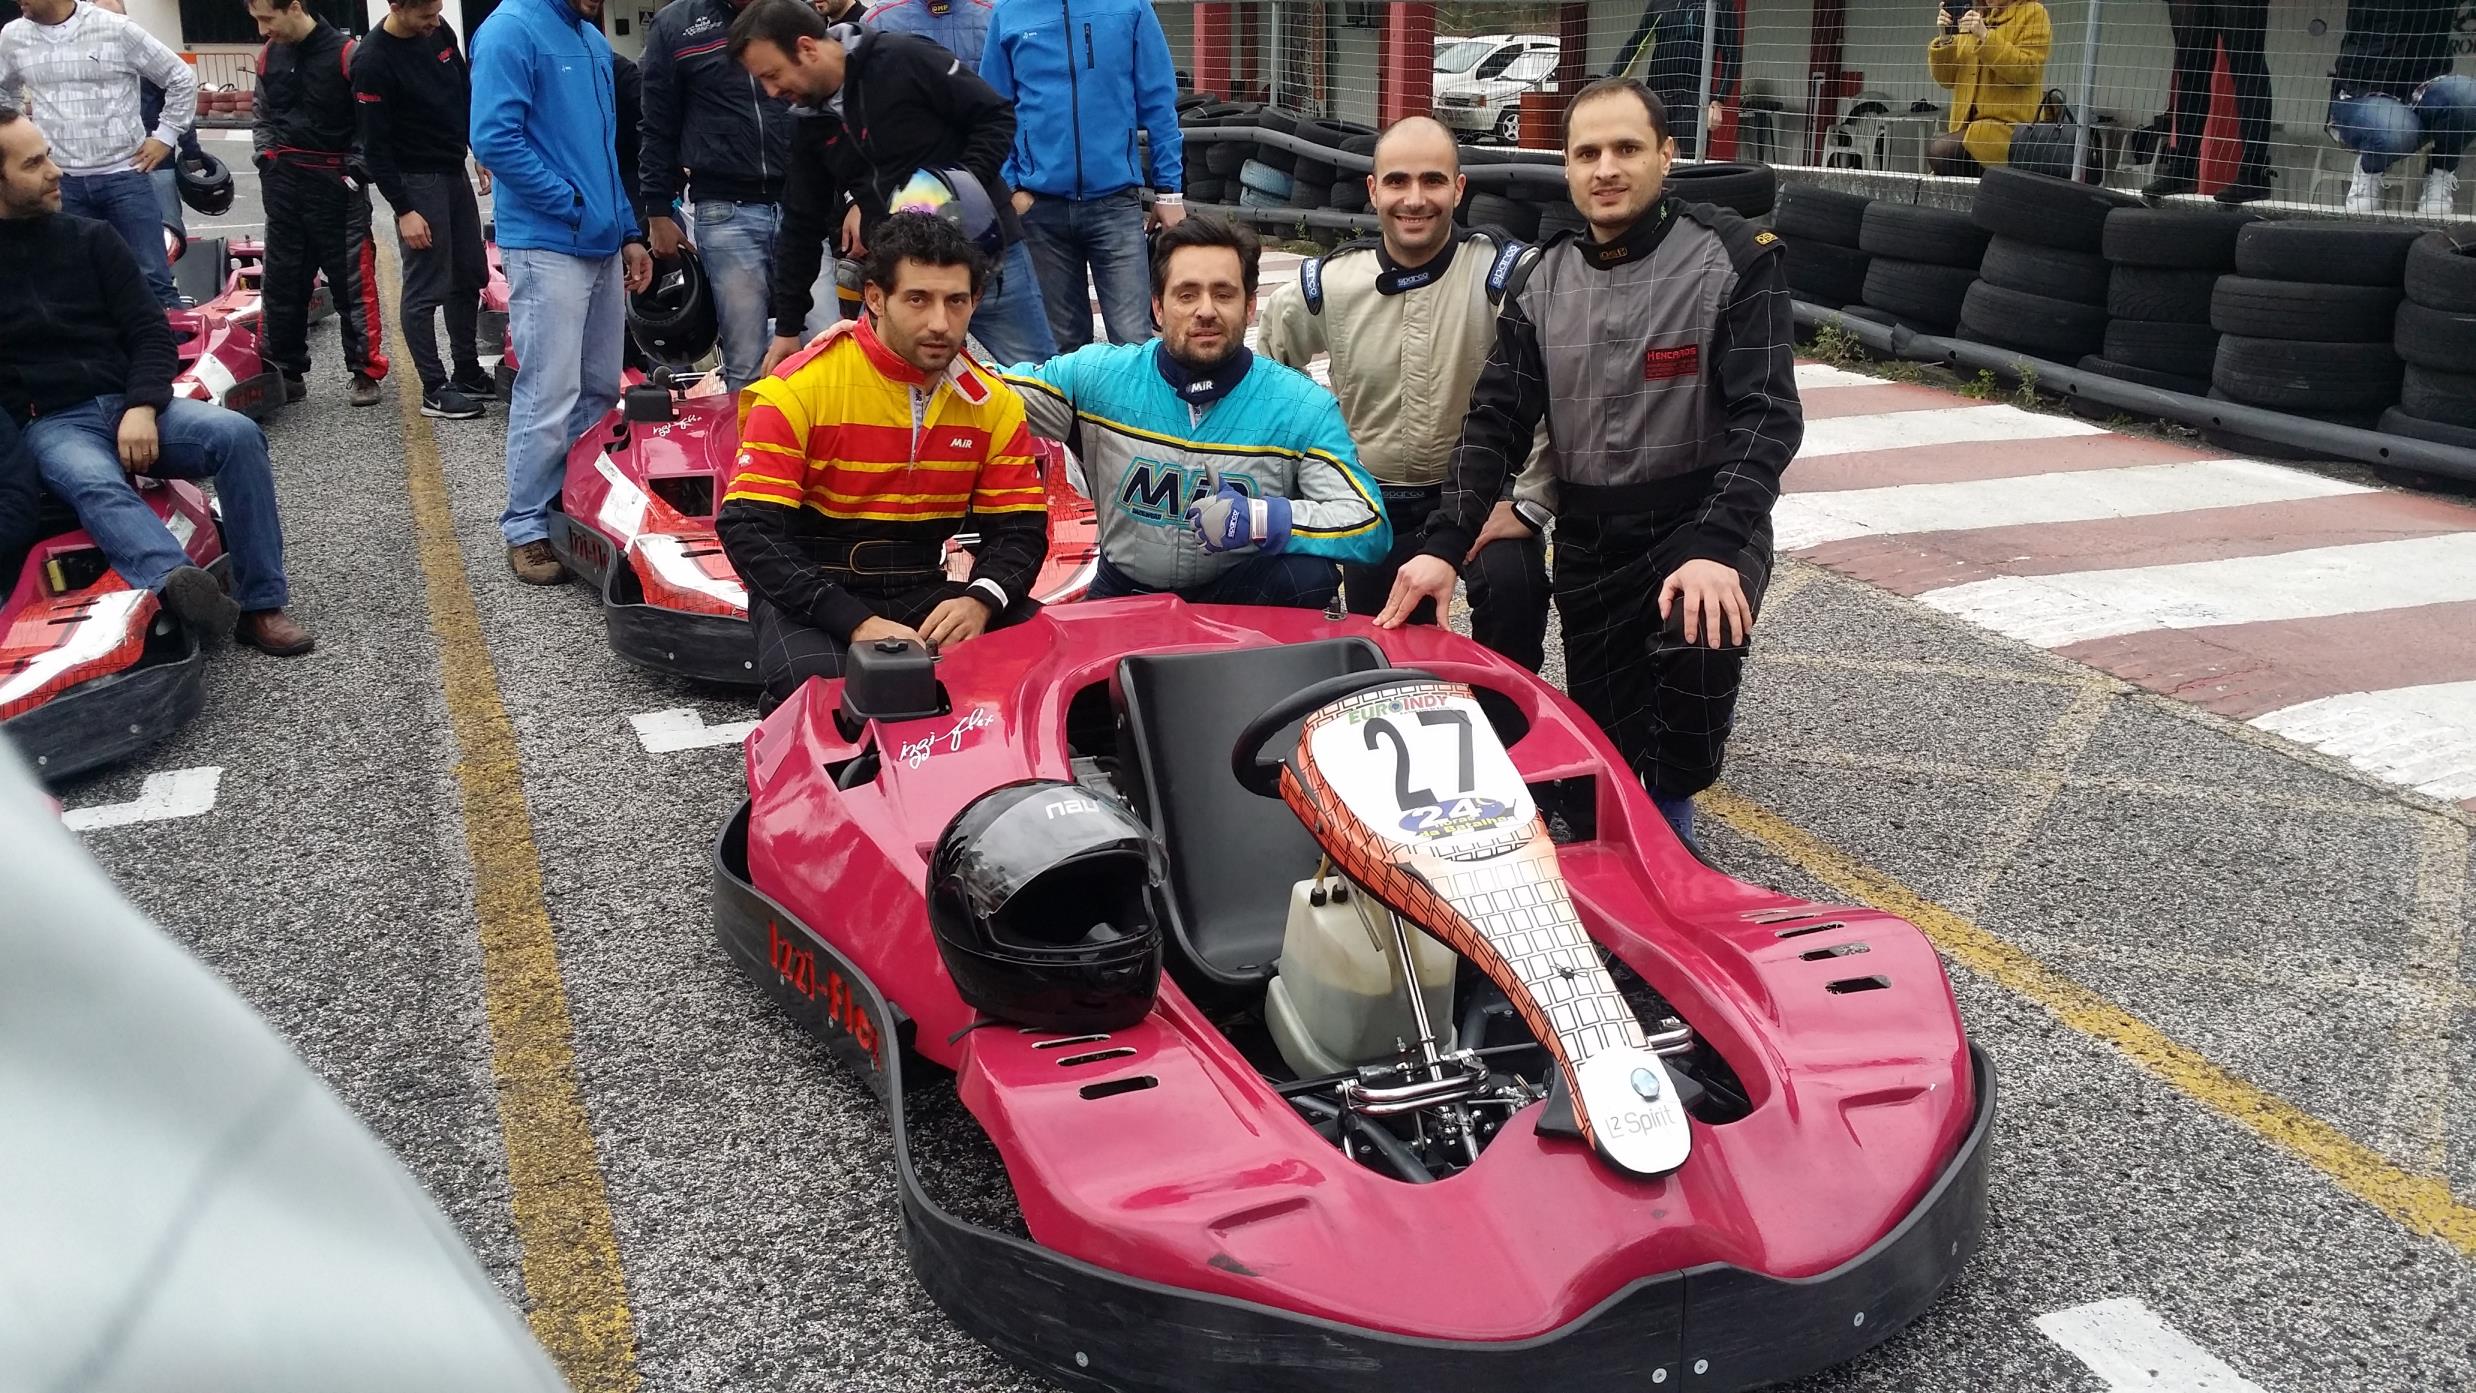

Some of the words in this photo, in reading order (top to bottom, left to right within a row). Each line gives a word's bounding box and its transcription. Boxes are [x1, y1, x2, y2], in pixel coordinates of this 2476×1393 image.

[1398, 272, 1429, 286] sparco
[1492, 244, 1521, 288] sparco
[1363, 709, 1475, 812] 27
[1411, 798, 1484, 833] 24
[1624, 1105, 1677, 1136] Spirit
